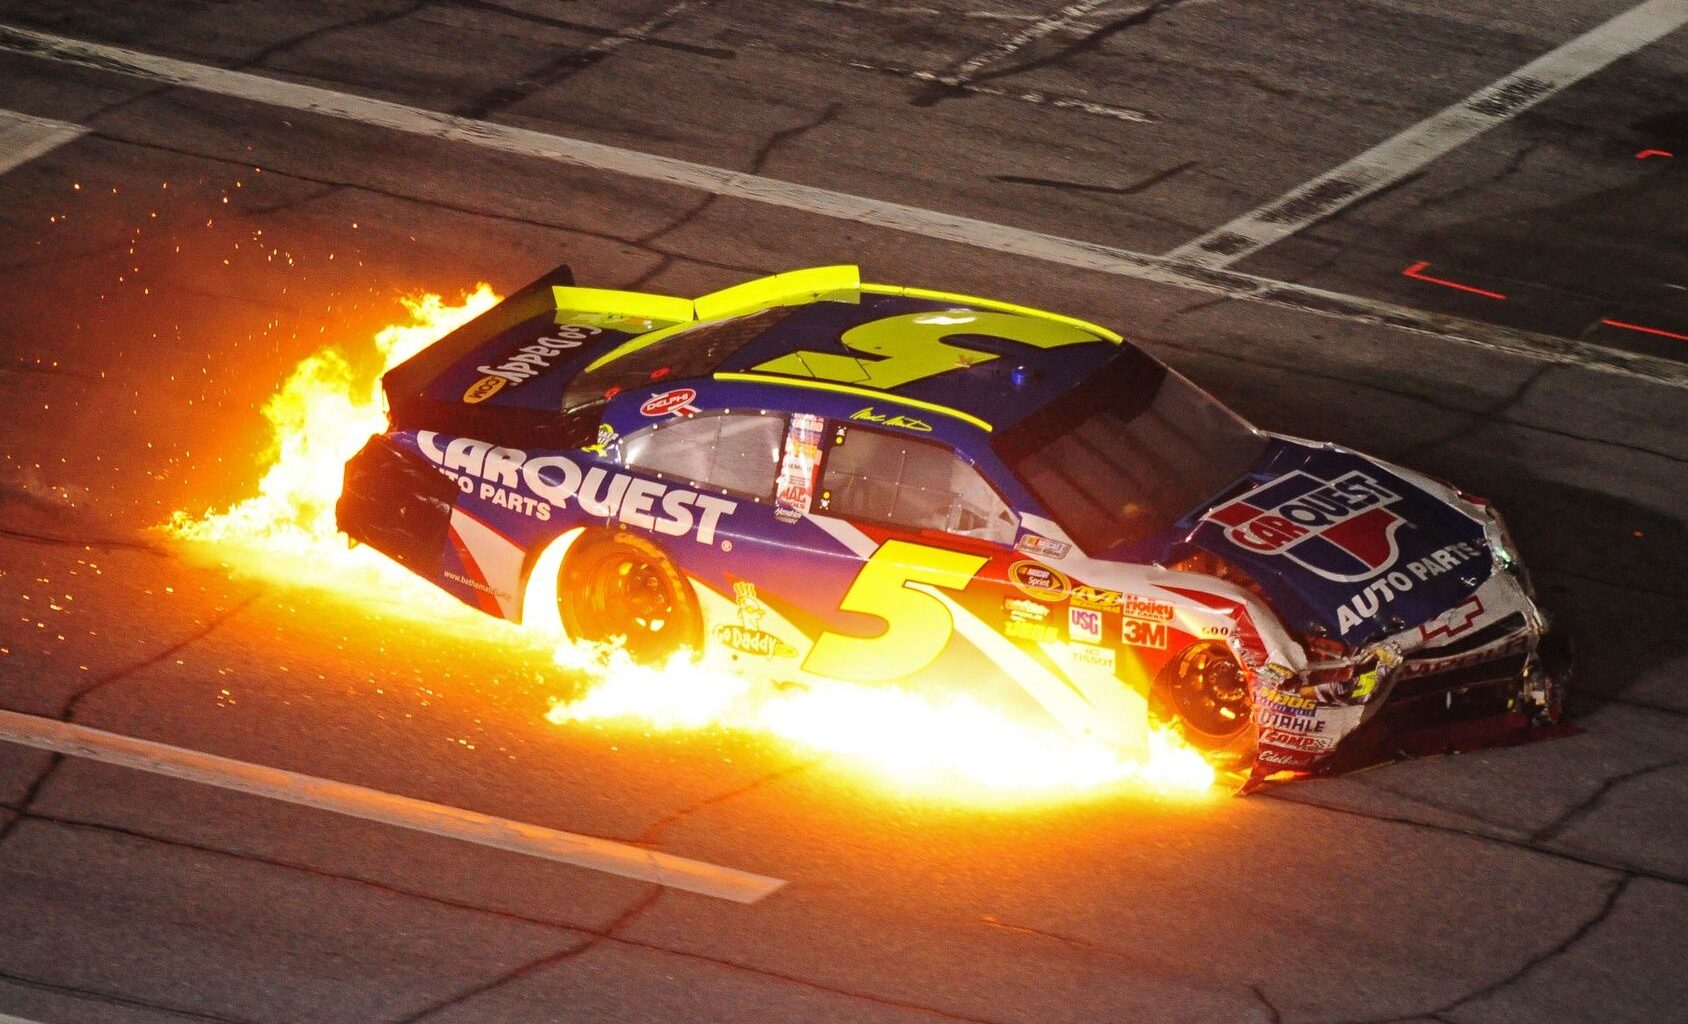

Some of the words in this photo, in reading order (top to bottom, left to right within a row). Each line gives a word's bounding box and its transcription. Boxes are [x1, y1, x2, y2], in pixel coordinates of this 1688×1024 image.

[646, 393, 689, 411] DELPHI
[417, 430, 737, 545] CARQUEST
[480, 482, 551, 521] PARTS
[1231, 474, 1395, 551] CARQUEST
[1028, 576, 1051, 588] Sprint
[1336, 571, 1413, 636] AUTO
[1406, 542, 1482, 582] PARTS
[800, 539, 992, 682] 5
[1125, 593, 1174, 620] Holley
[1071, 609, 1099, 635] USG
[1124, 620, 1166, 647] 3M
[1259, 686, 1317, 711] MOOG
